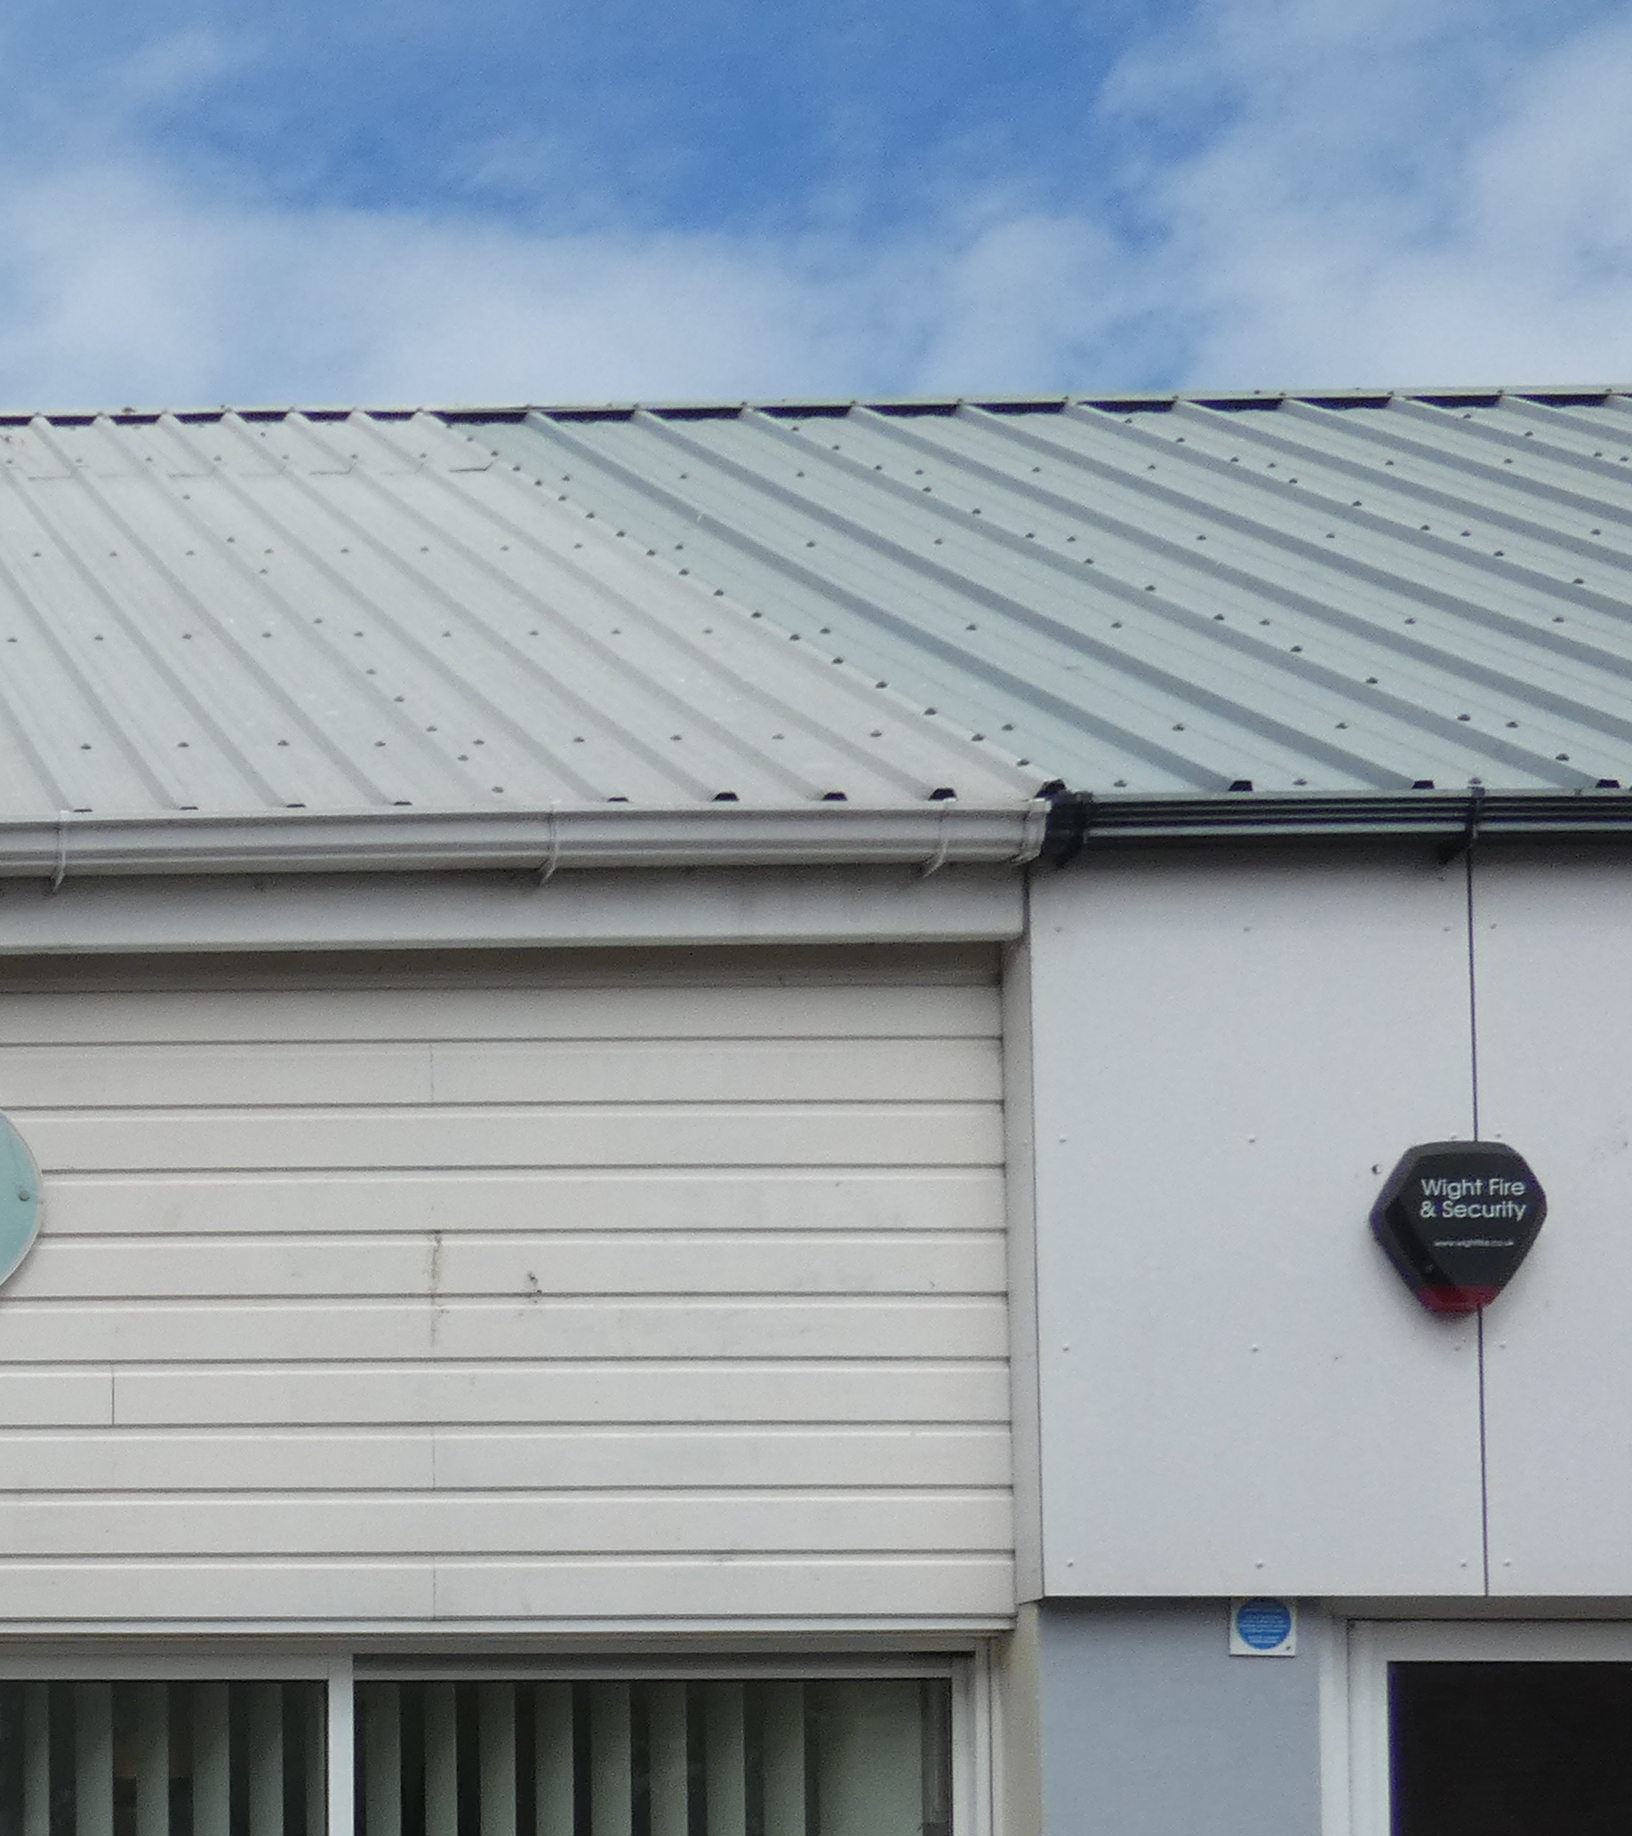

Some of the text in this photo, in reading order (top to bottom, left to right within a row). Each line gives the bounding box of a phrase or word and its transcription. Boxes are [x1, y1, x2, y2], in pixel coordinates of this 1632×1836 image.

[1421, 1178, 1526, 1200] Wight Fire
[1420, 1200, 1527, 1221] & Security
